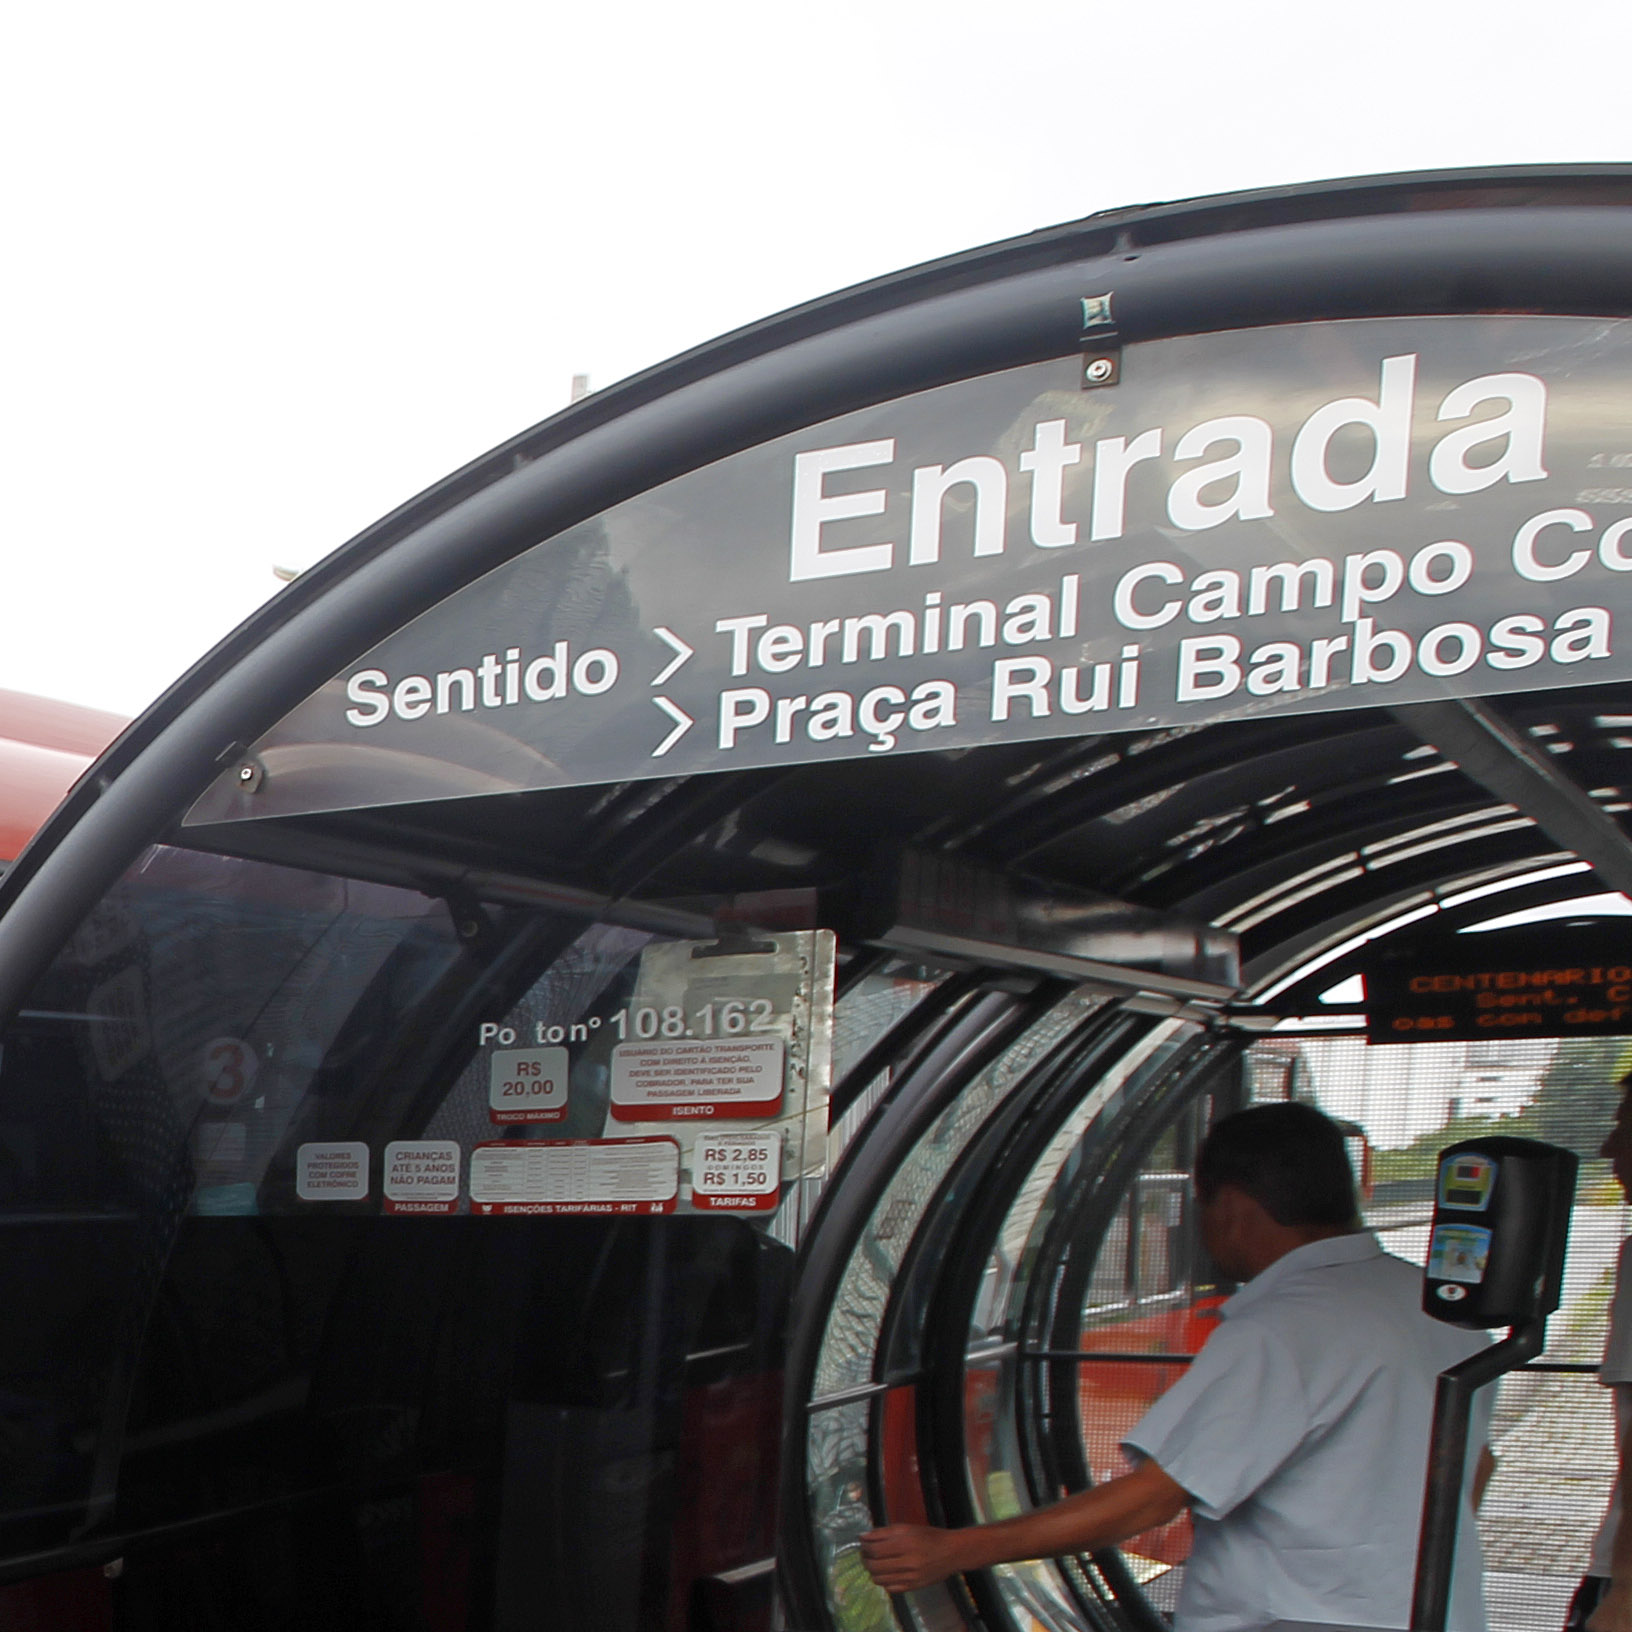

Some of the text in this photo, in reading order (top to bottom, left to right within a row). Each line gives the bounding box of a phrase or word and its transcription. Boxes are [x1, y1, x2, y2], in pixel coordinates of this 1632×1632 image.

[789, 353, 1549, 583] Entrada
[714, 573, 1079, 679] Terminal
[1113, 535, 1475, 634] Campo
[343, 640, 622, 729] Sentido
[716, 605, 1612, 754] Praça Rui Barbosa
[609, 998, 775, 1041] 108.162
[660, 1046, 674, 1056] DO
[676, 1044, 712, 1055] CARTÃO
[715, 1043, 775, 1053] TRANSPORTE
[640, 1058, 661, 1067] COM
[663, 1057, 699, 1066] DIREITO
[207, 1044, 245, 1098] 3
[654, 1068, 671, 1077] SER
[674, 1066, 736, 1076] IDENTIFICADO
[739, 1065, 763, 1074] PELO
[690, 1077, 714, 1086] PARA
[717, 1076, 734, 1085] TER
[646, 1087, 742, 1098] PASSAGEM LIBERADA
[672, 1105, 715, 1116] ISENTO
[395, 1151, 454, 1163] CRIANÇAS
[423, 1163, 456, 1173] ANOS
[390, 1174, 457, 1185] NÃO PAGAM
[394, 1202, 449, 1212] PASSAGEM
[709, 1197, 757, 1207] TARIFAS
